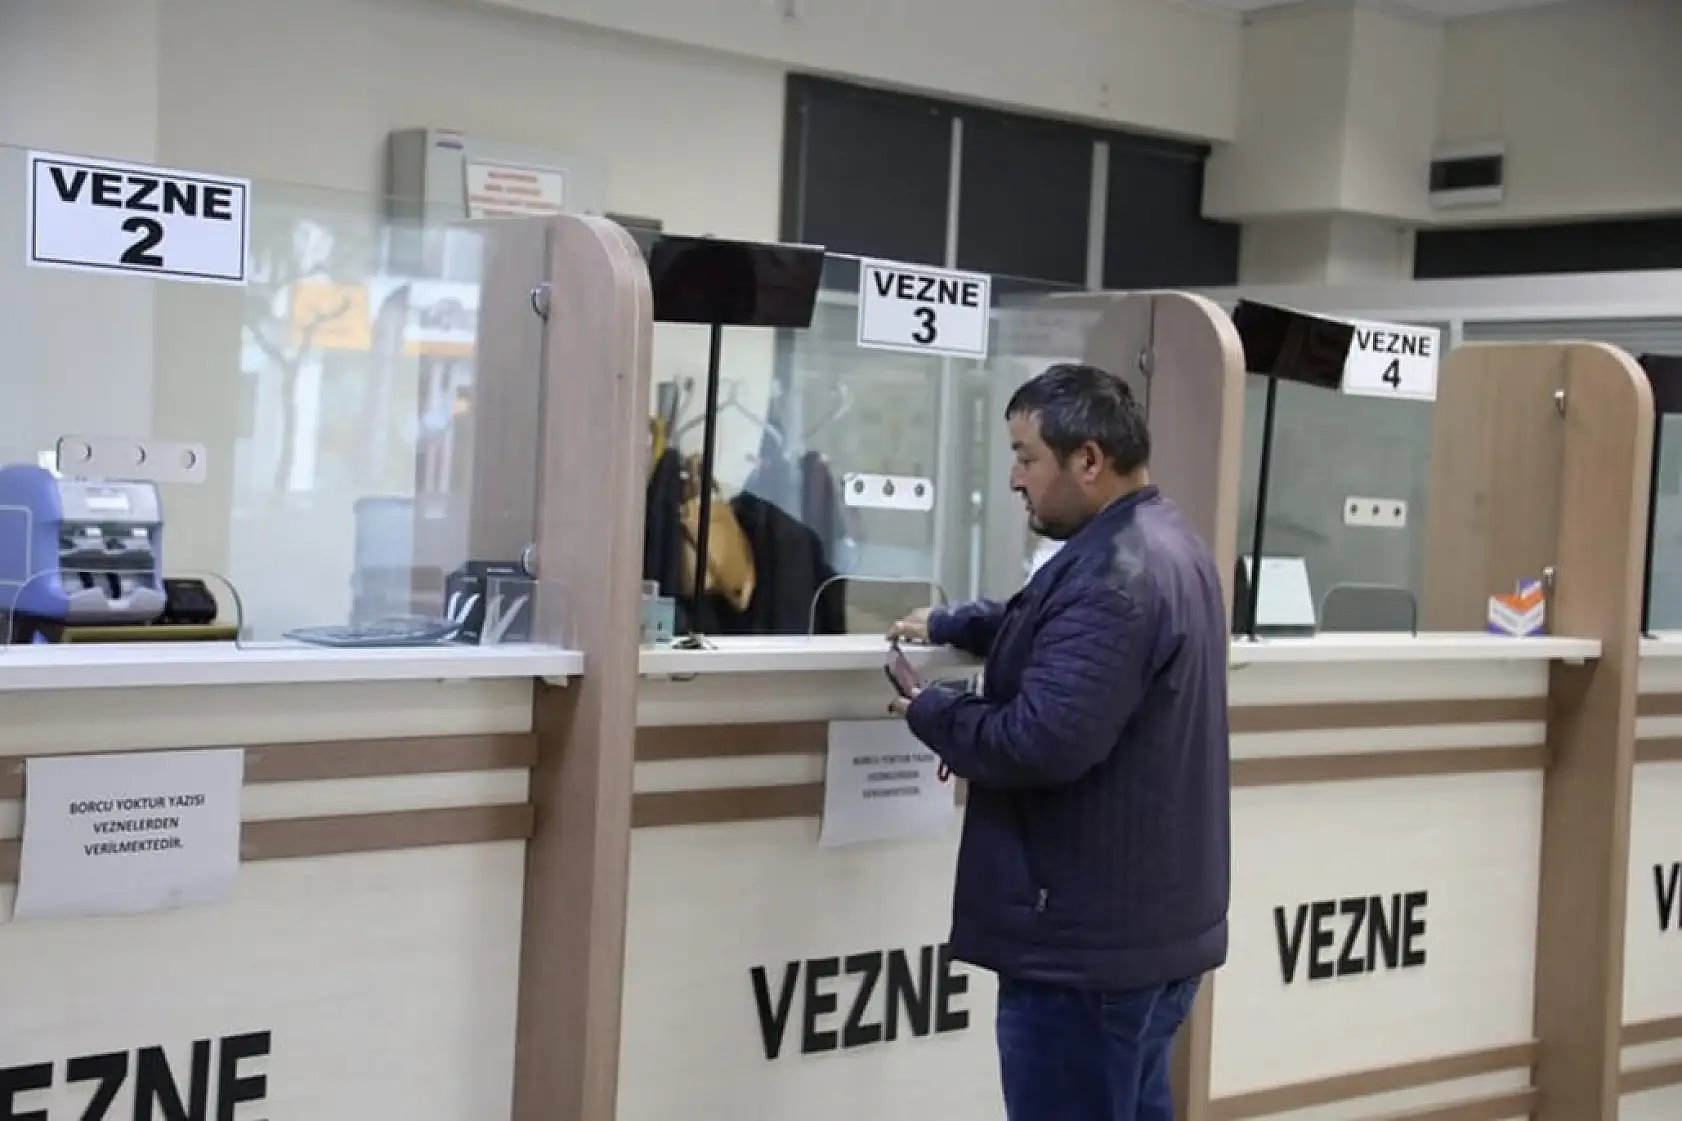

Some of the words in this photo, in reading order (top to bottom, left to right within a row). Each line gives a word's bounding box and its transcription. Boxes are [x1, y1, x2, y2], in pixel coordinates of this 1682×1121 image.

[50, 167, 233, 220] VEZNE
[120, 216, 164, 267] 2
[874, 271, 979, 307] VEZNE
[912, 307, 937, 344] 3
[1357, 329, 1431, 357] VEZNE
[1382, 358, 1401, 388] 4
[117, 797, 166, 811] YOKTUR
[93, 816, 179, 834] VEZNELERDEN
[1274, 891, 1427, 984] VEZNE
[750, 944, 969, 1060] VEZNE
